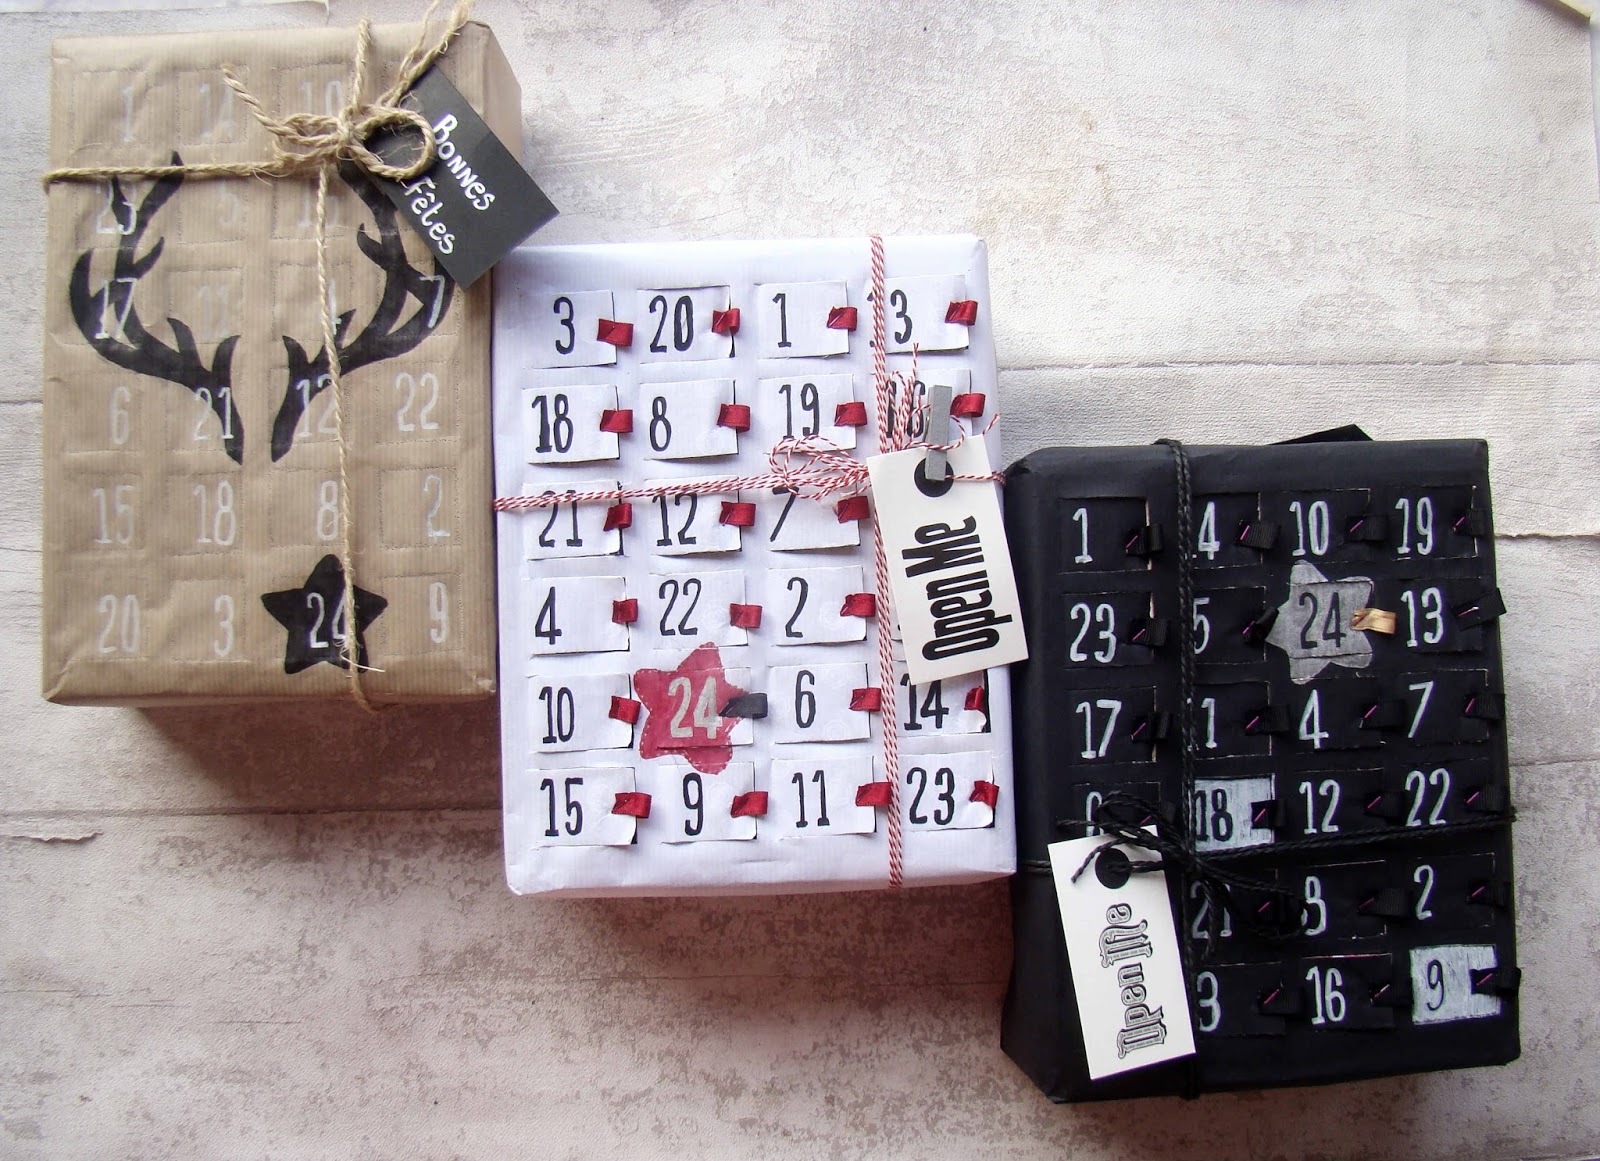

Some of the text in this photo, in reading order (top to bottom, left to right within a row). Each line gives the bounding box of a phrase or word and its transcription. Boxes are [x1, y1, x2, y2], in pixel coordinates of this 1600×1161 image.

[94, 277, 139, 340] 17
[419, 274, 445, 329] 7
[553, 296, 576, 355] 3
[649, 294, 695, 353] 20
[772, 292, 792, 348] 1
[110, 386, 131, 445] 6
[193, 386, 235, 441] 21
[296, 373, 339, 437] 12
[396, 371, 440, 432] 22
[531, 393, 574, 454] 18
[650, 396, 672, 452] 8
[778, 382, 820, 439] 19
[93, 484, 136, 544] 15
[193, 480, 237, 546] 18
[317, 480, 339, 541] 8
[424, 474, 451, 538] 2
[538, 490, 583, 548] 21
[651, 492, 697, 546] 12
[770, 486, 800, 543] 7
[1072, 507, 1093, 564] 1
[1289, 500, 1330, 556] 10
[1395, 497, 1434, 555] 19
[429, 581, 449, 643] 9
[534, 586, 562, 645] 4
[658, 577, 702, 636] 22
[785, 576, 809, 638] 2
[901, 515, 1013, 662] Open Me
[1400, 587, 1444, 647] 13
[96, 594, 140, 654] 20
[213, 594, 235, 657] 3
[306, 592, 348, 649] 24
[1070, 603, 1117, 663] 23
[1299, 592, 1346, 649] 24
[538, 686, 575, 744] 10
[668, 675, 723, 740] 24
[795, 669, 817, 729] 6
[900, 673, 950, 731] 14
[1299, 689, 1330, 749] 4
[1408, 681, 1434, 738] 7
[1076, 699, 1122, 759] 17
[539, 776, 584, 837] 15
[682, 772, 704, 837] 9
[791, 769, 831, 829] 11
[906, 767, 956, 826] 23
[1194, 788, 1233, 842] 18
[1299, 780, 1341, 834] 12
[1404, 767, 1450, 827] 22
[1301, 876, 1327, 936] 8
[1413, 865, 1434, 920] 2
[1098, 902, 1168, 1060] Open Me
[1305, 966, 1345, 1025] 16
[1427, 960, 1445, 1012] 9
